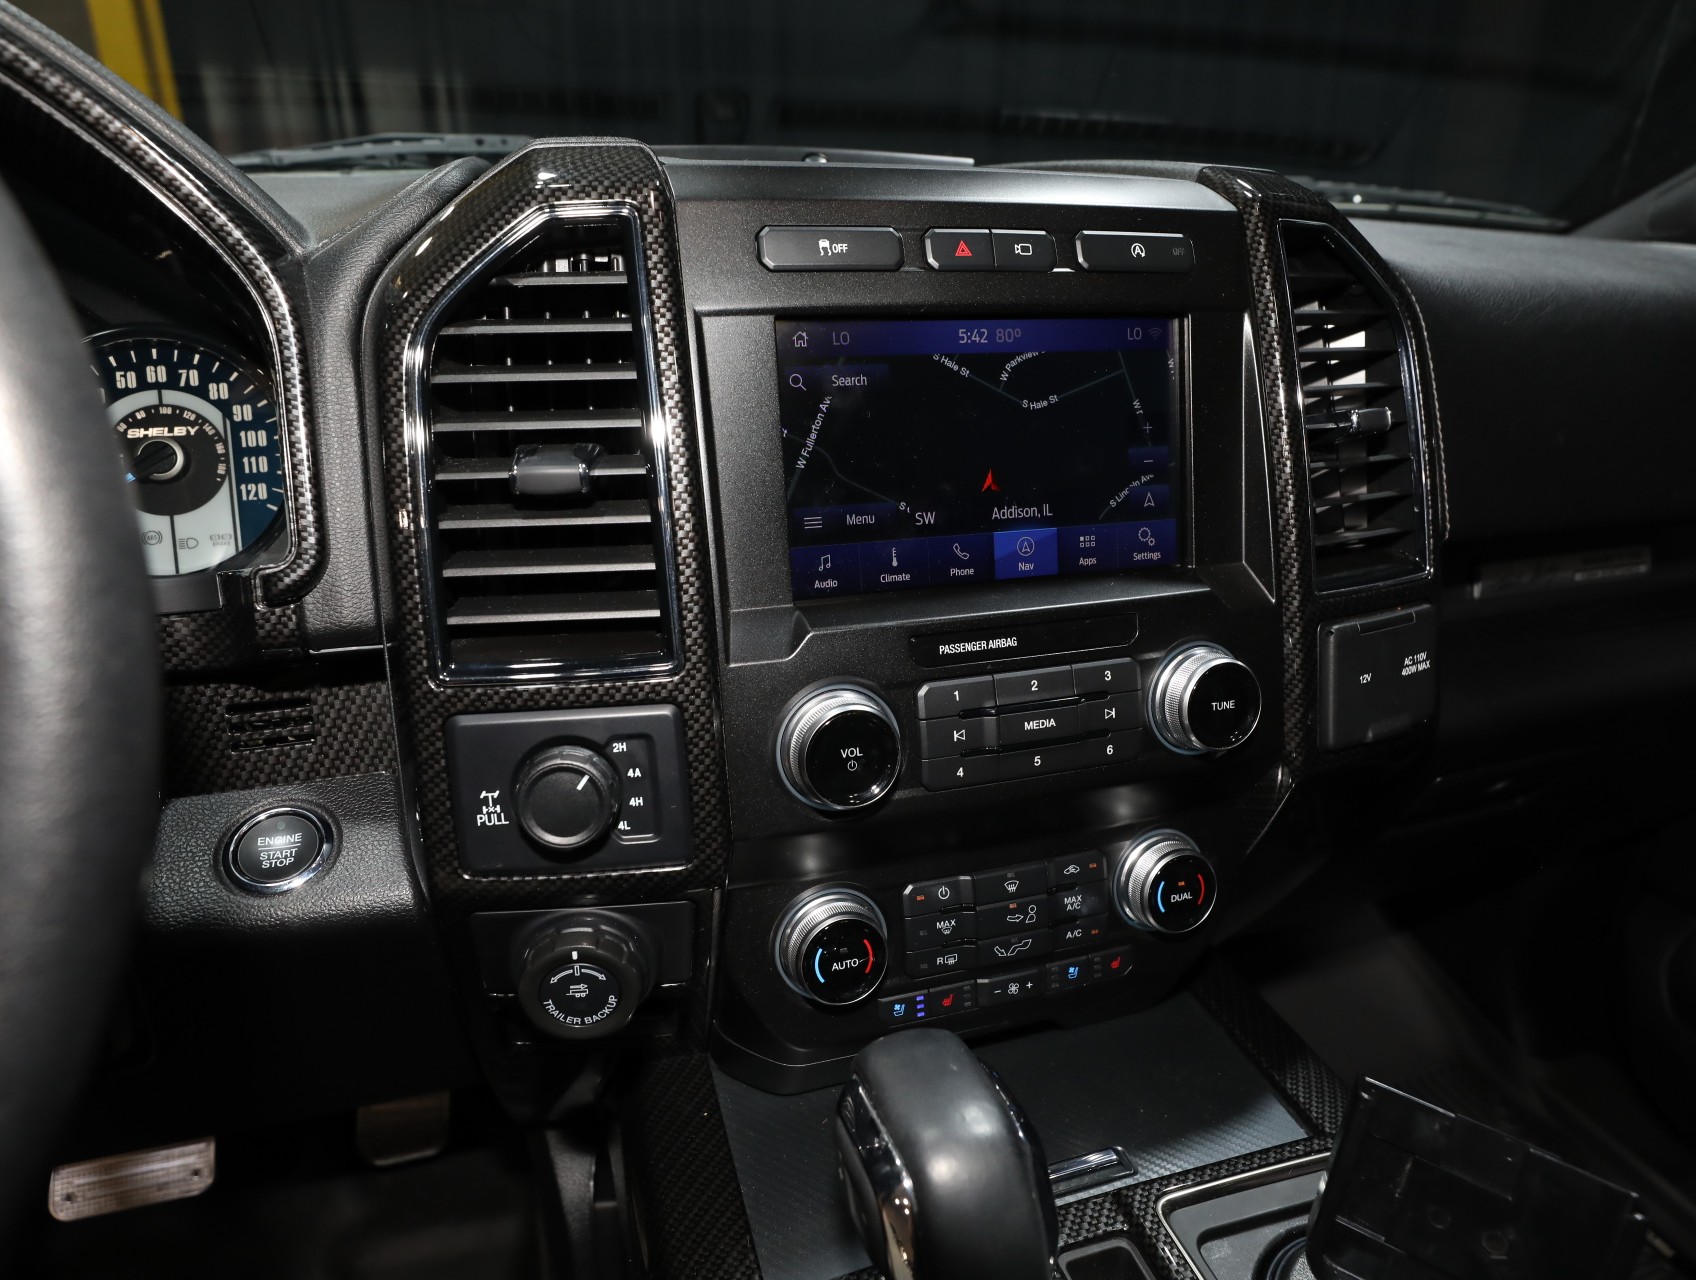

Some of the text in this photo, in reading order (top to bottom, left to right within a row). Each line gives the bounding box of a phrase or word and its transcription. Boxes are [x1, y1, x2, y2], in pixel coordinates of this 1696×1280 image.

[832, 243, 849, 254] OFF
[1172, 248, 1185, 256] OFF
[832, 332, 850, 345] LO
[958, 328, 989, 344] 5:42
[1127, 327, 1142, 341] LO
[940, 356, 959, 372] Hale
[959, 366, 970, 378] St
[999, 351, 1039, 381] W Parkview
[115, 370, 137, 389] 50
[146, 365, 167, 384] 60
[178, 369, 199, 387] 70
[832, 374, 868, 387] Search
[208, 382, 229, 400] 80
[1022, 394, 1059, 410] S Hale St
[134, 410, 147, 420] 80
[159, 406, 172, 414] 100
[182, 410, 197, 421] 120
[232, 404, 253, 422] 90
[126, 426, 200, 439] SHELBY
[202, 423, 216, 436] 140
[240, 430, 268, 448] 100
[795, 456, 807, 470] W
[801, 412, 825, 458] Fullerton
[242, 456, 268, 474] 110
[240, 482, 268, 501] 120
[1109, 499, 1117, 508] S
[1115, 480, 1140, 502] Lincln
[992, 504, 1054, 520] Addison, IL
[846, 514, 875, 526] Menu
[915, 511, 936, 526] SW
[1078, 556, 1097, 567] Apps
[1133, 550, 1162, 562] Settings
[950, 566, 975, 578] Phone
[1018, 562, 1035, 572] Nav
[814, 578, 838, 590] Audio
[880, 572, 911, 584] Climate
[939, 636, 1018, 656] PASSENGER AIRBAG
[1404, 651, 1428, 666] AC 110V
[1401, 659, 1431, 676] 400W MAX
[1104, 670, 1112, 682] 3
[1359, 672, 1372, 684] 12V
[1030, 680, 1039, 692] 2
[954, 690, 960, 702] 1
[1211, 700, 1236, 711] TUNE
[1024, 718, 1056, 731] MEDIA
[612, 742, 627, 753] 2H
[840, 747, 863, 758] VOL
[1106, 744, 1114, 755] 6
[1034, 756, 1042, 766] 5
[627, 767, 642, 778] 4A
[956, 767, 964, 778] 4
[629, 796, 644, 808] 4H
[476, 812, 510, 827] PULL
[618, 820, 631, 831] 4L
[257, 832, 303, 846] ENGINE
[260, 848, 298, 860] START
[261, 857, 295, 869] STOP
[1064, 894, 1082, 906] MAX
[1170, 891, 1193, 903] DUAL
[1066, 902, 1082, 912] A/C
[936, 918, 956, 930] MAX
[1066, 929, 1082, 939] A/C
[831, 958, 859, 972] AUTO
[936, 956, 944, 966] R
[542, 994, 618, 1025] TRAILER BACKUP
